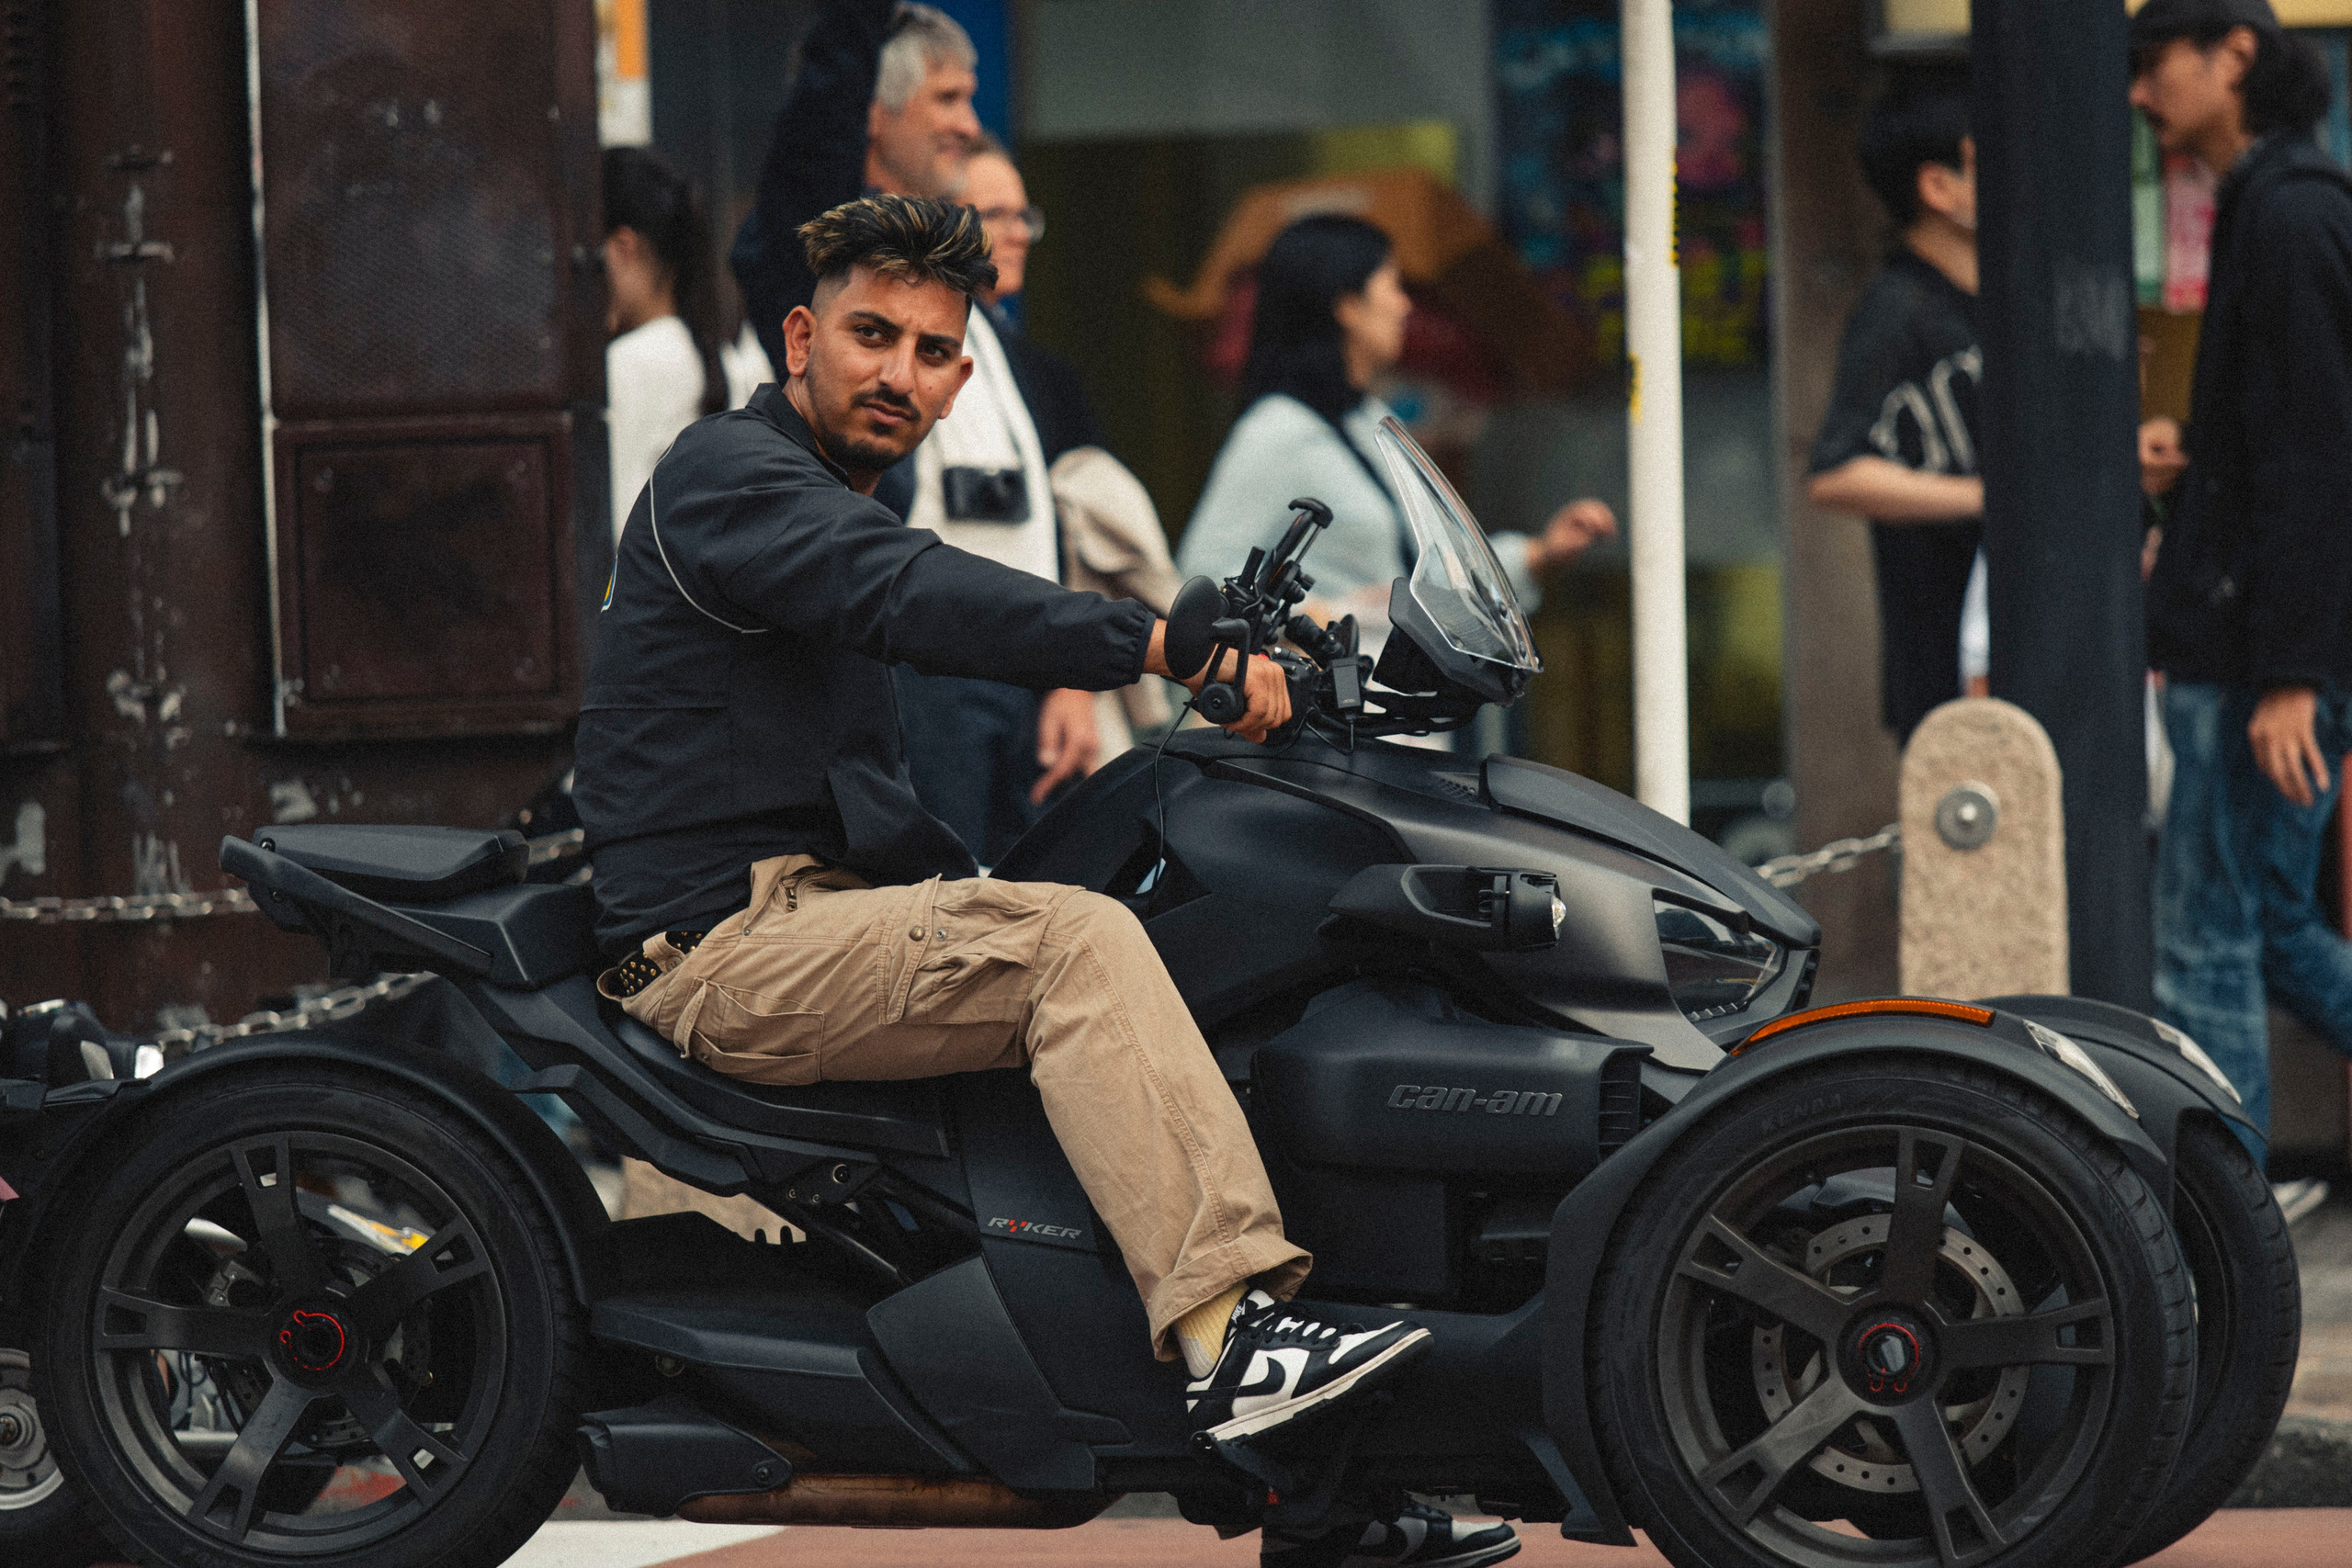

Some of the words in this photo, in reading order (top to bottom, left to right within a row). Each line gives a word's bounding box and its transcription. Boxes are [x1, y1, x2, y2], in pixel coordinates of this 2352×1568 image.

[1388, 1085, 1563, 1115] can-am
[1761, 1093, 1842, 1134] KENDA
[988, 1217, 1082, 1238] RYKER
[1231, 1303, 1242, 1324] NIKE
